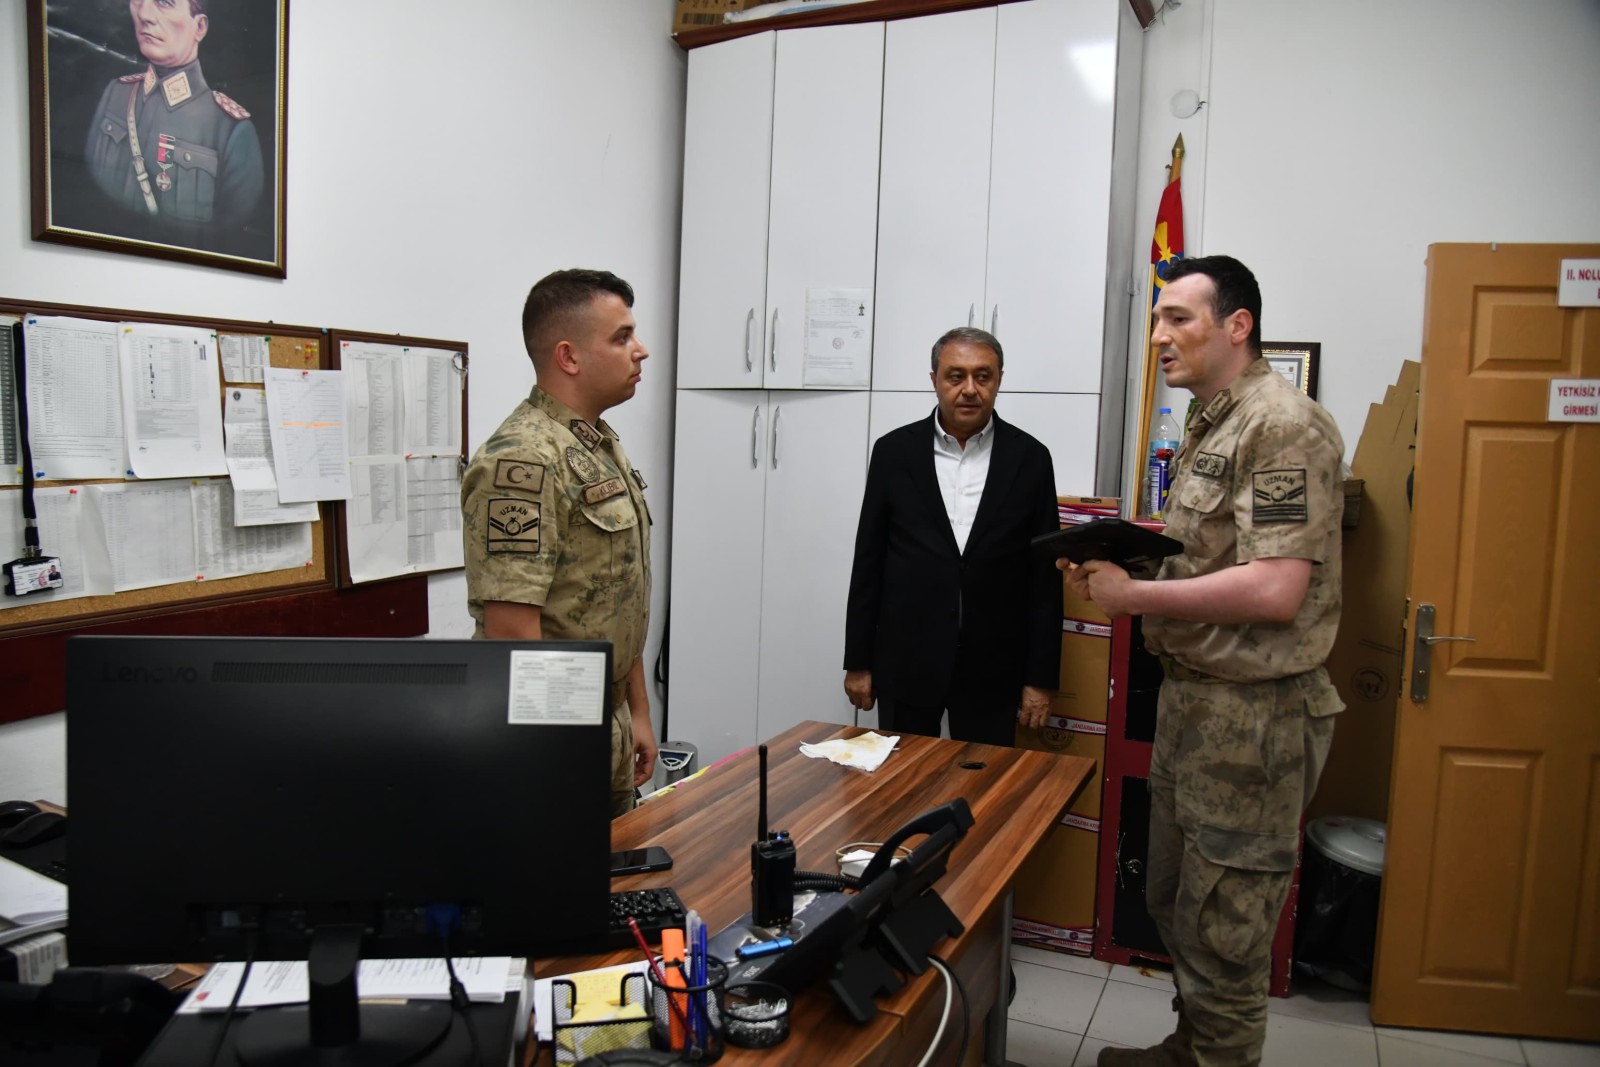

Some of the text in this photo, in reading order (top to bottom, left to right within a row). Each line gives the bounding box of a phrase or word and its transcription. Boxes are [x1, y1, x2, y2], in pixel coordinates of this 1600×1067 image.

[1557, 384, 1596, 398] YETKİSİZ
[1563, 402, 1598, 417] GİRMESİ
[1263, 475, 1296, 487] UZMAN
[500, 505, 529, 517] UZMAN
[103, 662, 199, 685] Lenovo
